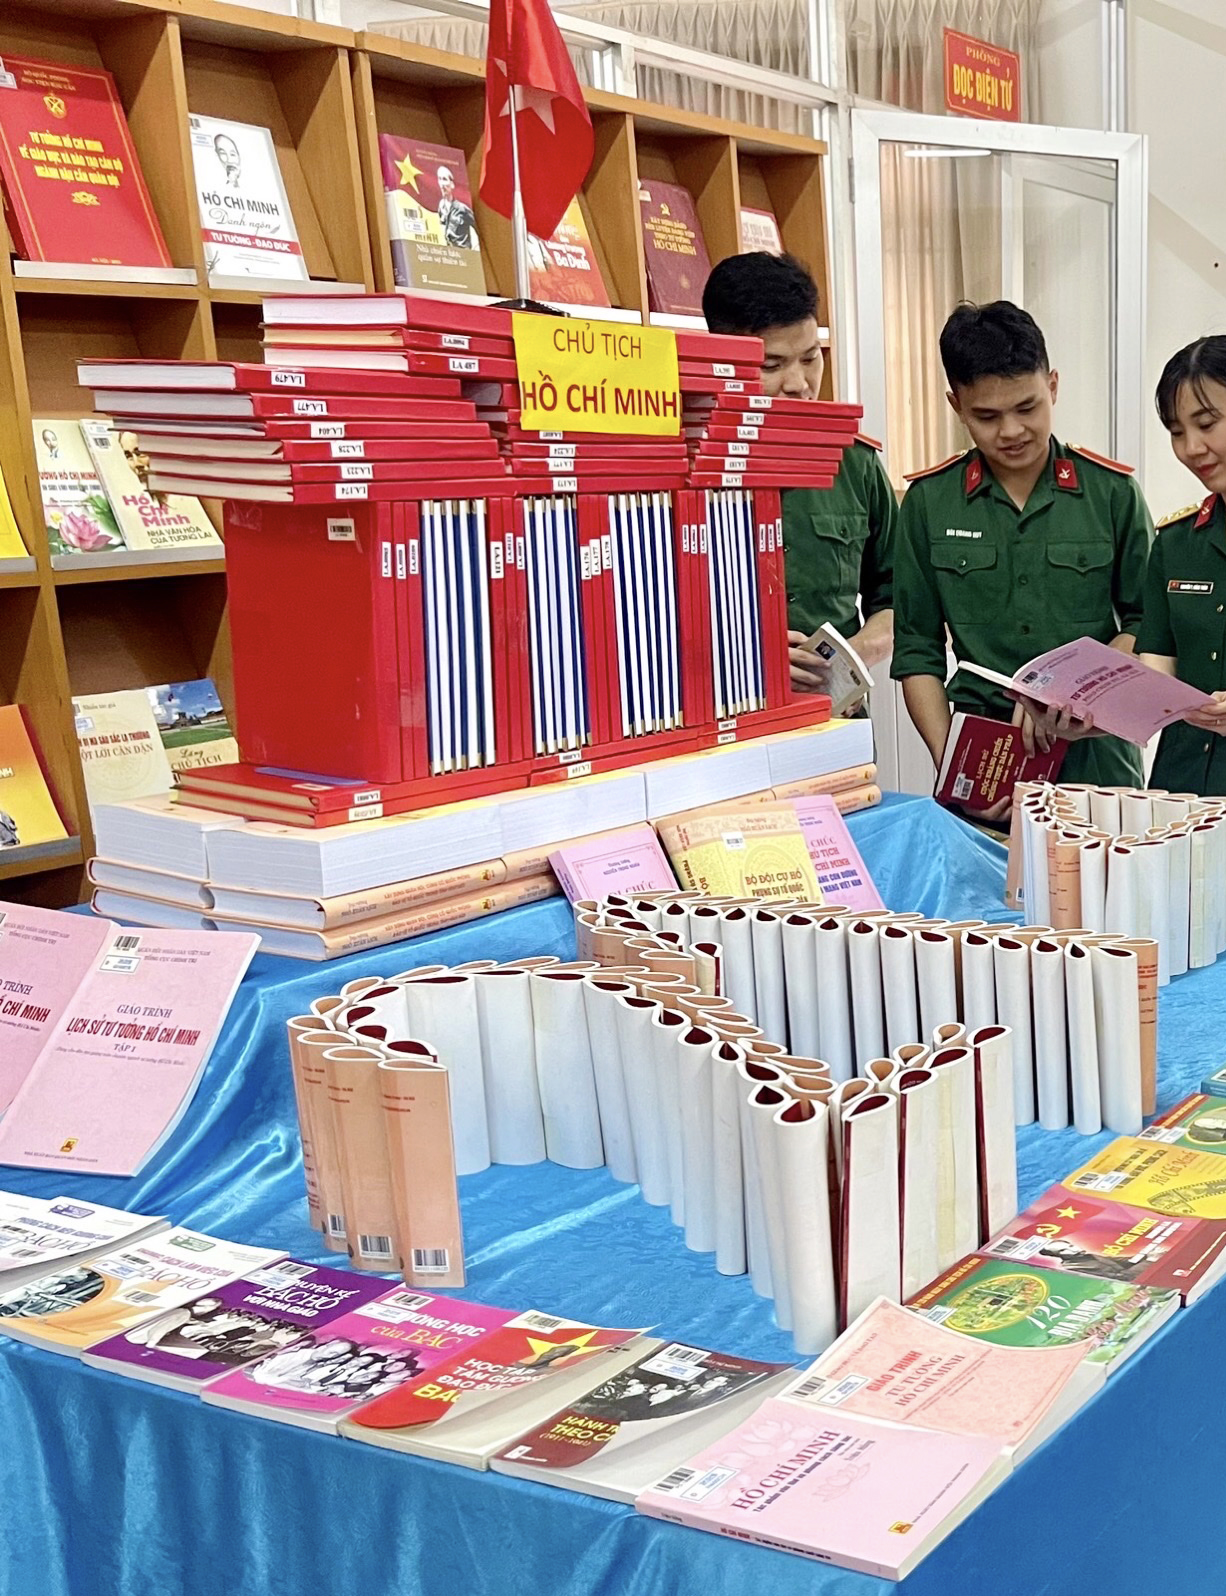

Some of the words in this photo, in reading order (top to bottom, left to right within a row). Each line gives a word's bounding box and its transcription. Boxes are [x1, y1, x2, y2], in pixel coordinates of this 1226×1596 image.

[202, 191, 221, 206] HỒ
[247, 200, 280, 216] MINH
[209, 208, 246, 226] Danh
[553, 323, 595, 355] CHỦ
[601, 333, 642, 361] TỊCH
[274, 373, 304, 384] LA.479
[521, 370, 558, 412] HỒ
[566, 379, 606, 416] CHÍ
[614, 387, 678, 418] MINH
[297, 402, 325, 413] LA.477
[142, 514, 191, 528] Minh
[81, 748, 93, 761] ỘT
[745, 874, 758, 886] BỘ
[758, 872, 775, 884] ĐỘI
[3, 980, 33, 996] TRÌNH
[23, 1006, 51, 1024] MINH
[117, 1004, 141, 1016] GIÁO
[142, 1005, 173, 1018] TRÌNH
[66, 1017, 88, 1036] LỊCH
[158, 1024, 178, 1044] CHÍ
[174, 1029, 201, 1046] MINH
[297, 1279, 336, 1298] HUYỆN
[1026, 1295, 1072, 1329] 120
[370, 1323, 402, 1340] của
[401, 1327, 464, 1350] BÁC
[450, 1321, 487, 1337] HỌC
[464, 1358, 504, 1373] HỌC
[866, 1373, 895, 1392] GIÁO
[888, 1350, 923, 1374] TRÌNH
[932, 1354, 966, 1377] MINH
[550, 1424, 593, 1440] THEO
[562, 1415, 609, 1431] HÀNH
[730, 1487, 765, 1510] HỒ
[759, 1463, 800, 1488] CHÍ
[787, 1430, 841, 1466] MINH
